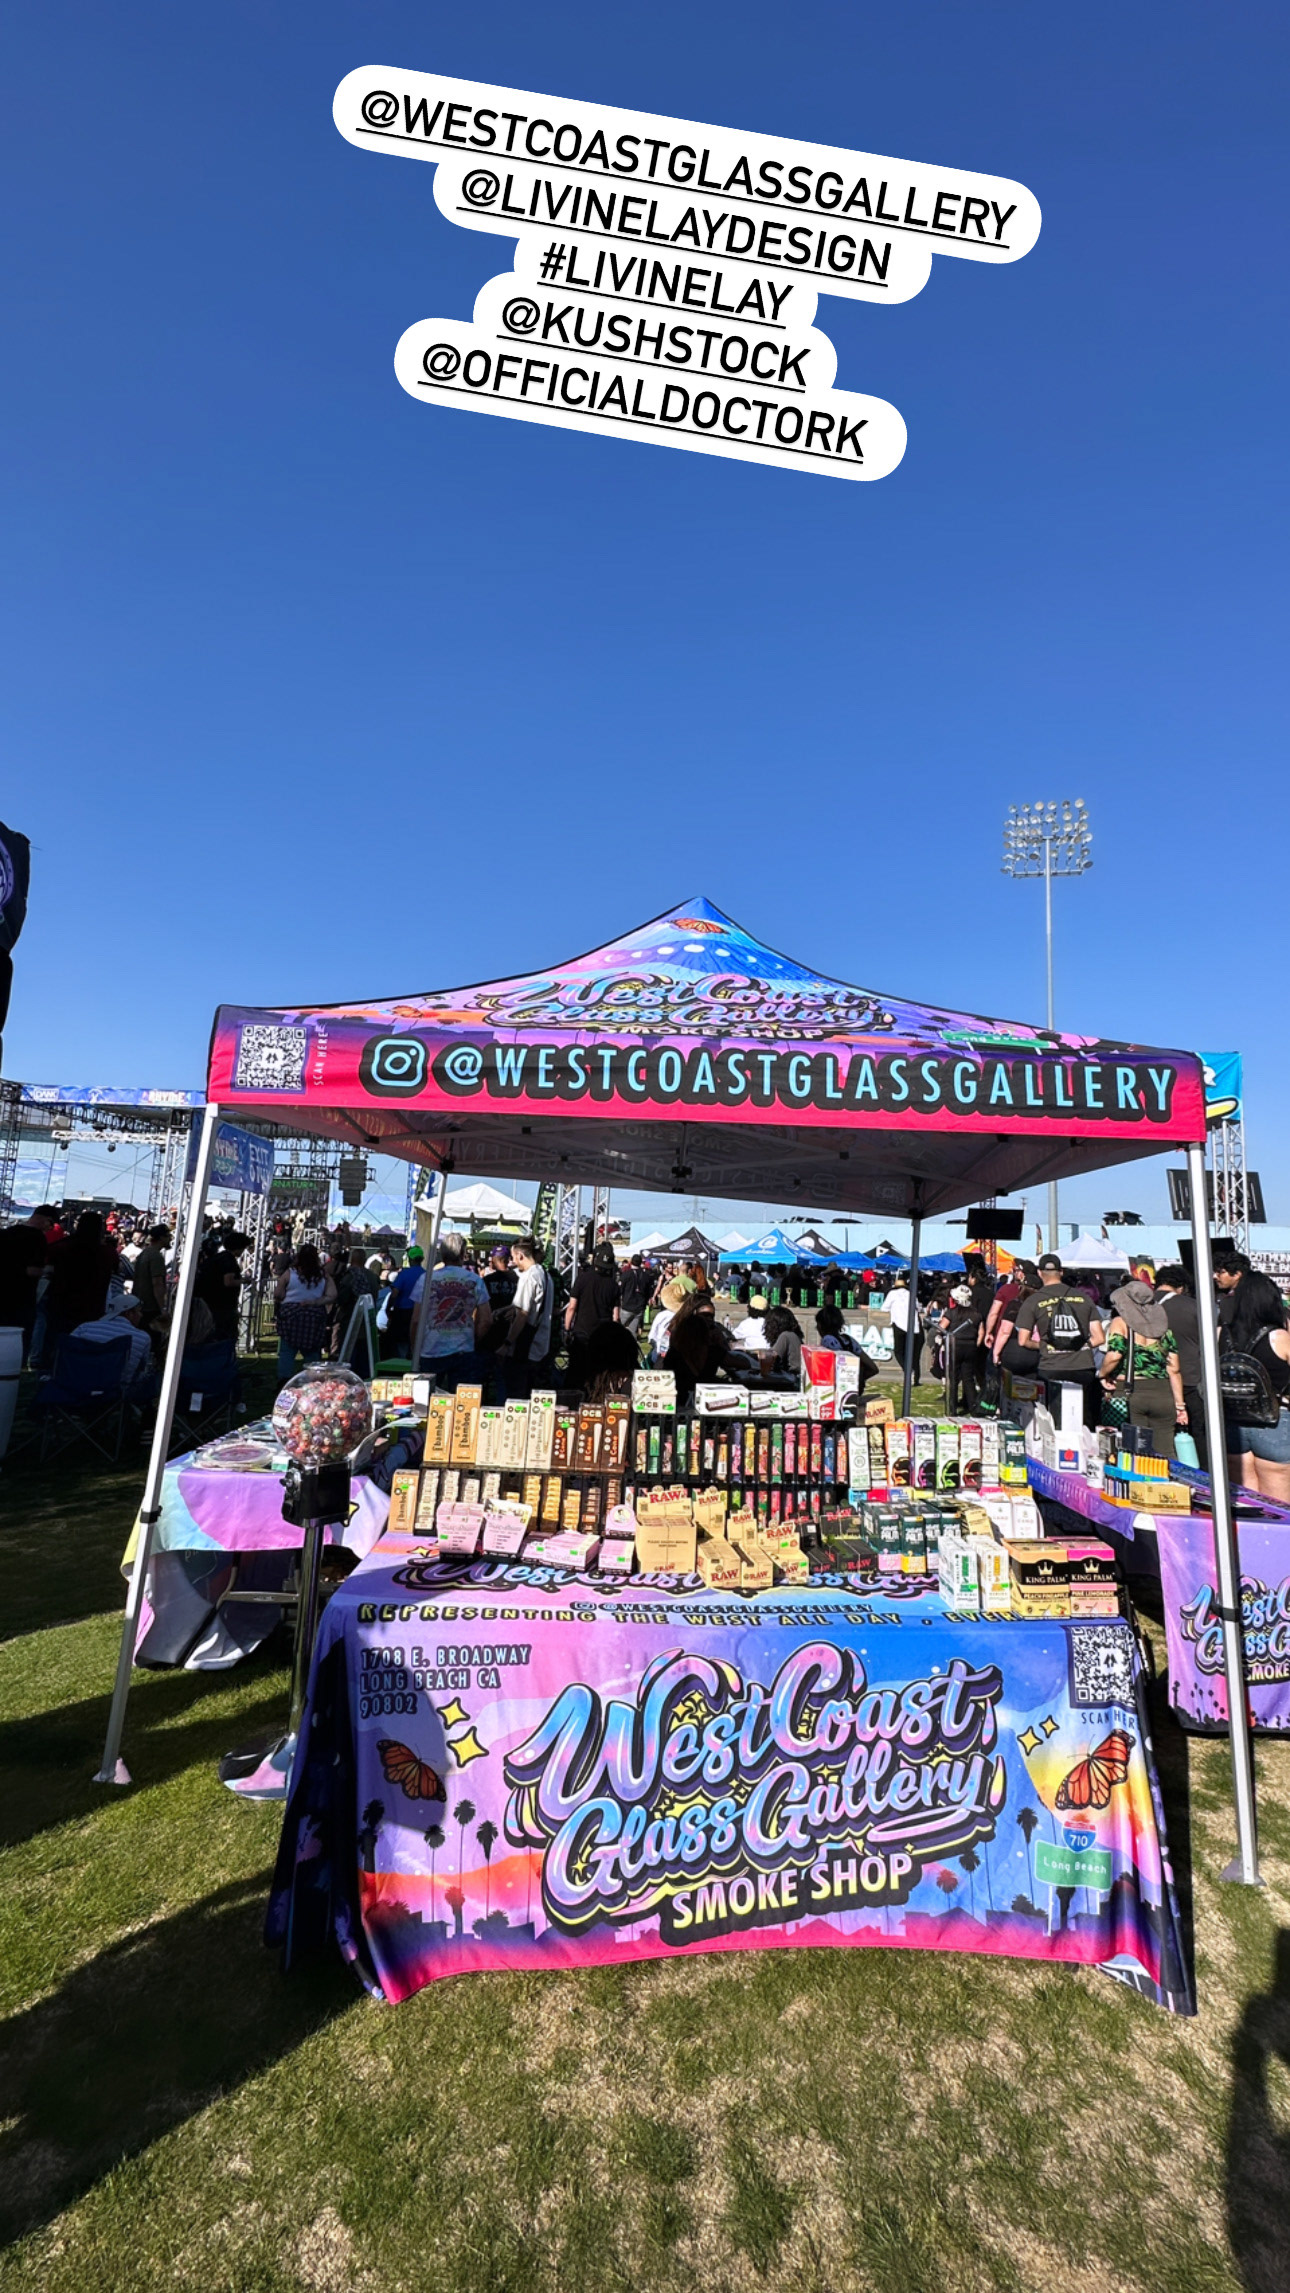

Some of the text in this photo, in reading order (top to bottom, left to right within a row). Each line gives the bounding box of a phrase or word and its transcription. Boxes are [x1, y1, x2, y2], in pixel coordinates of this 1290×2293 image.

[731, 1027, 825, 1039] SHOP
[313, 1032, 328, 1085] SCAN HERE
[444, 1046, 1173, 1112] @WESTCOASTGLASSGALLERY
[865, 1406, 887, 1418] RAW
[649, 1490, 682, 1504] RAW
[698, 1494, 720, 1505] RAW
[732, 1513, 752, 1523] RAW
[765, 1526, 794, 1539] RAW
[658, 1563, 676, 1572] RAW
[847, 1558, 871, 1570] RAW
[711, 1569, 738, 1582] RAW
[749, 1570, 768, 1580] RAW
[1025, 1576, 1046, 1584] KING
[1071, 1573, 1092, 1581] KING
[359, 1602, 597, 1622] REPRESENTING
[612, 1612, 669, 1624] THE
[684, 1613, 762, 1626] WEST
[779, 1614, 832, 1626] ALL
[844, 1613, 903, 1625] DAY
[361, 1645, 531, 1670] 1708 E. BROADWAY
[1246, 1661, 1290, 1681] MOKE
[360, 1668, 501, 1694] LONG BEACH CA
[361, 1692, 418, 1717] 90802
[1081, 1709, 1138, 1730] SCAN HER
[1070, 1834, 1089, 1847] 710
[1043, 1855, 1107, 1875] Long Beach
[672, 1851, 914, 1930] SMOKE SHOP
